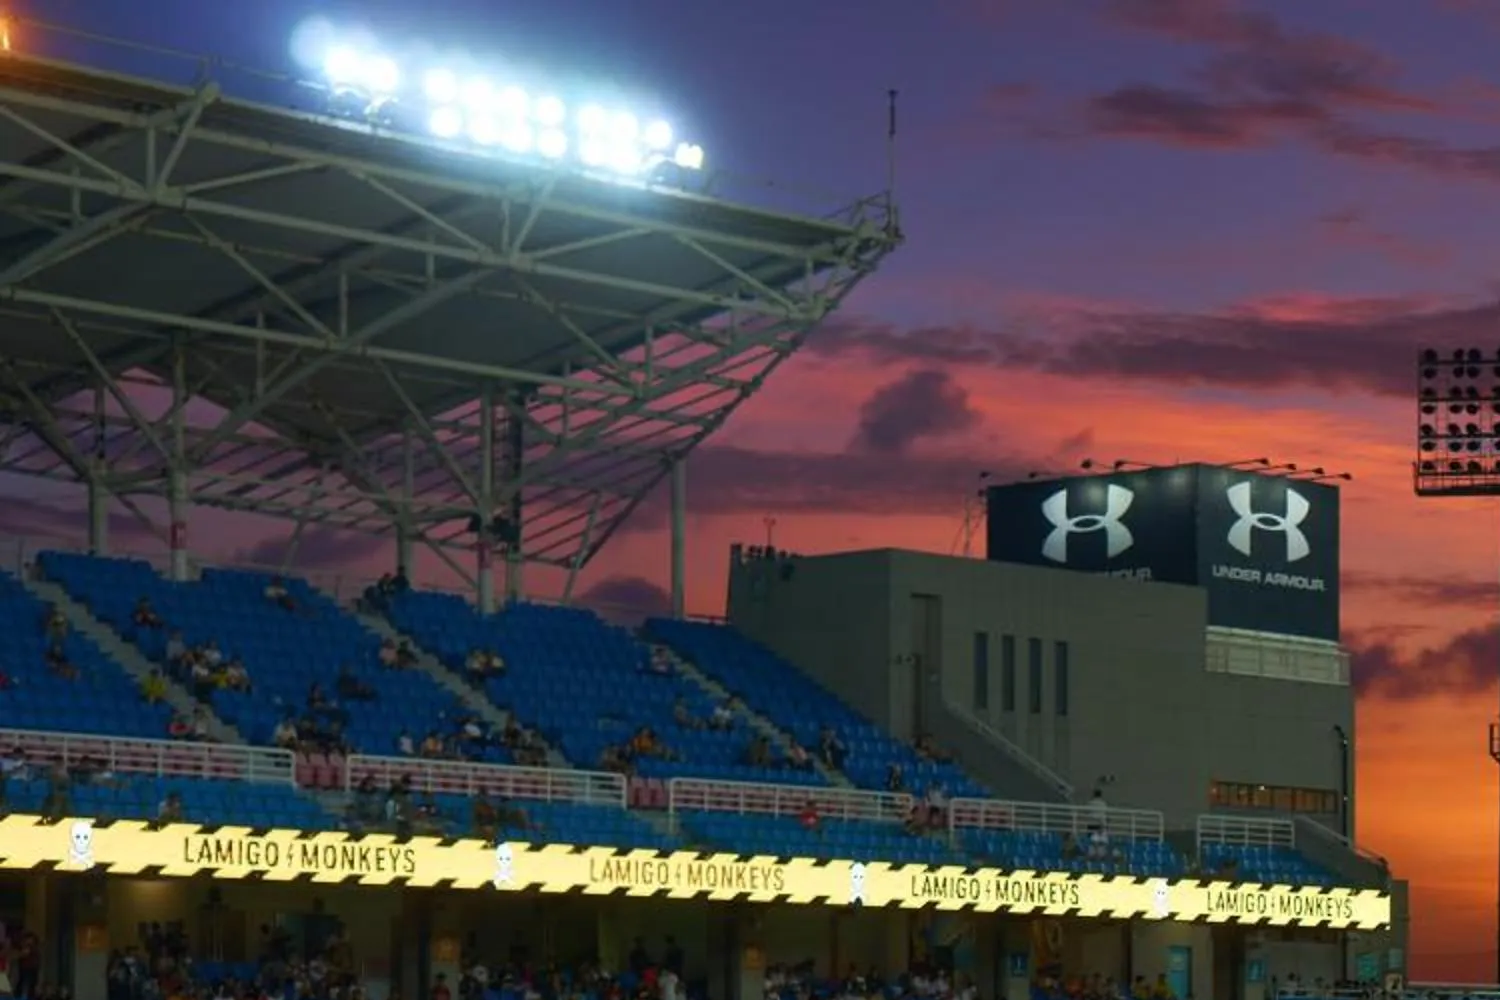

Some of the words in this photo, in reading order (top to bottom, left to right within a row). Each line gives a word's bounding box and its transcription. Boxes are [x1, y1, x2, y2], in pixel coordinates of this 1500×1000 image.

[1212, 564, 1261, 583] UNDER
[1264, 571, 1325, 592] ARMOUR
[184, 837, 280, 867] LAMIGO
[301, 843, 416, 873] MONKEYS
[589, 858, 670, 885] LAMIGO
[687, 863, 785, 891] MONKEYS
[911, 875, 981, 900] LAMIGO
[995, 879, 1079, 905] MONKEYS
[1206, 891, 1266, 914] LAMIGO
[1279, 895, 1353, 919] MONKEYS
